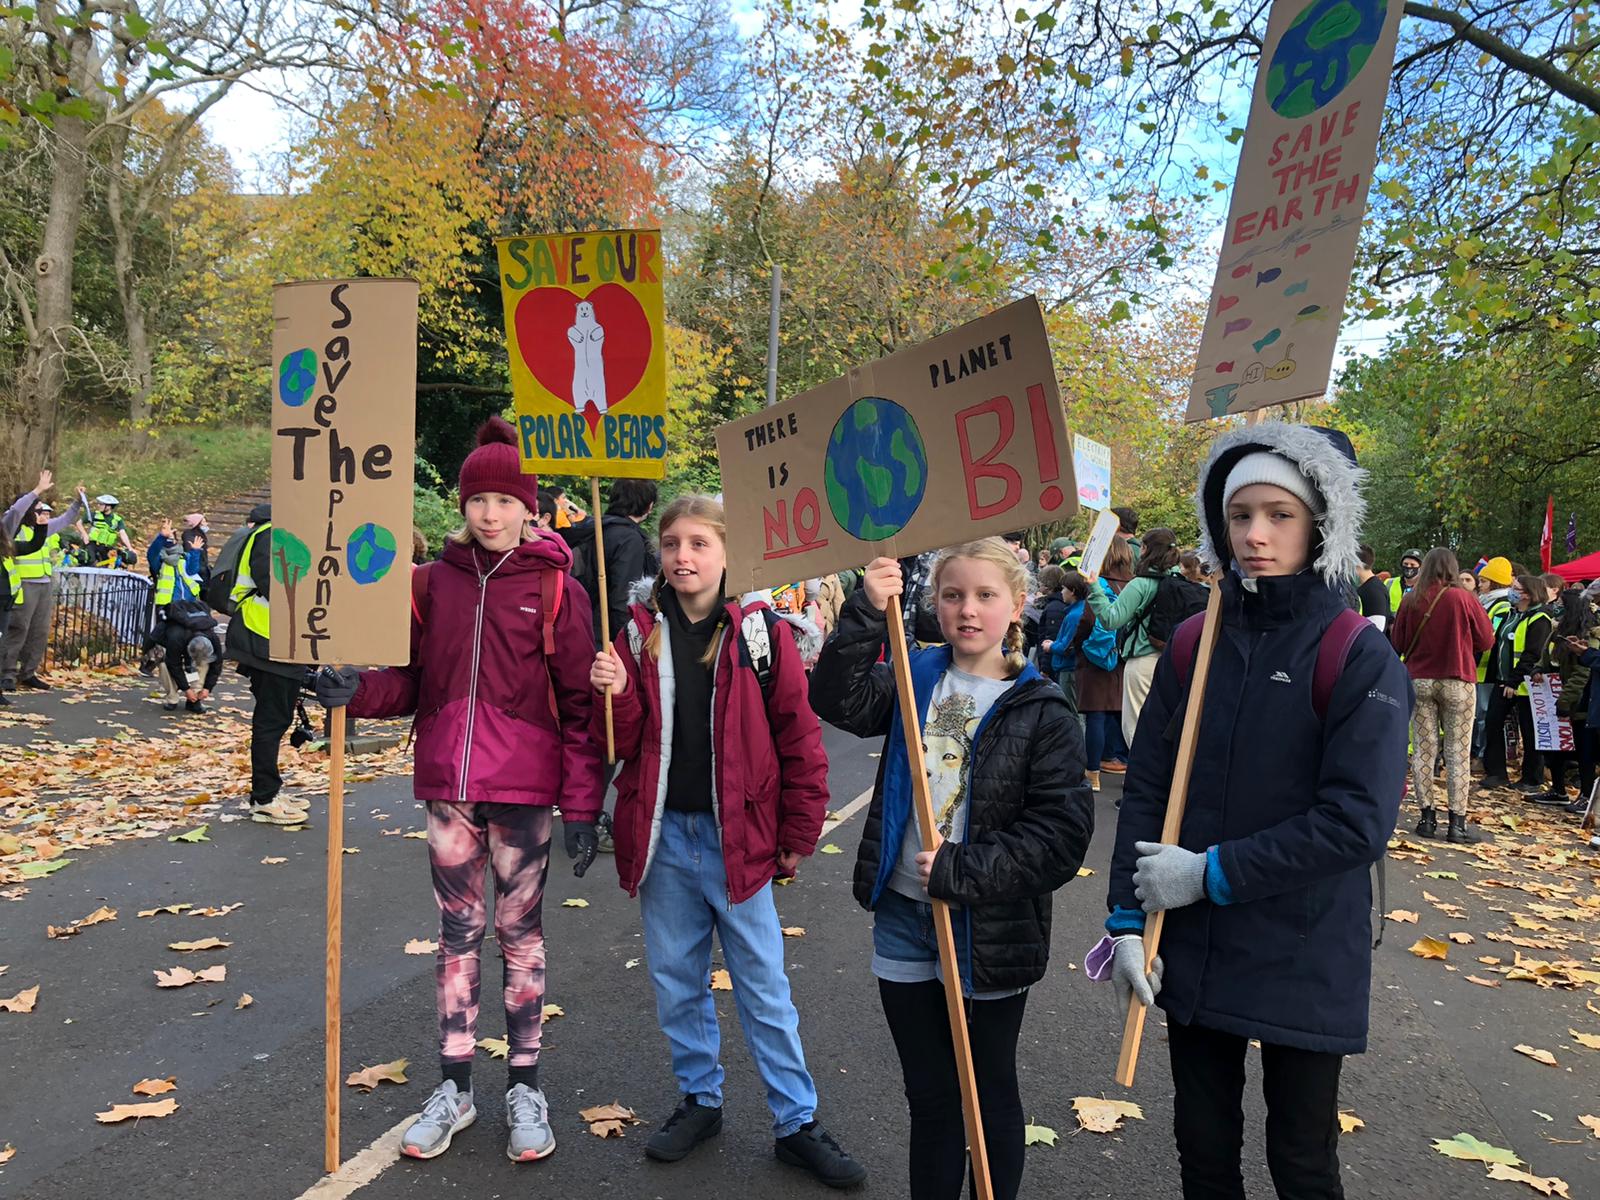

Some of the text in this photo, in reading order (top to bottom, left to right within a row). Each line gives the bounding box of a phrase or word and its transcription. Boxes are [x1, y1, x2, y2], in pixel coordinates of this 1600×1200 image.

[1267, 101, 1362, 167] SAVE
[1272, 145, 1343, 196] THE
[1232, 174, 1361, 245] EARTH
[504, 234, 658, 290] SAVE OUR
[929, 334, 1013, 388] PLANET
[1245, 367, 1261, 381] HI
[277, 427, 393, 485] The
[519, 413, 668, 460] POLAR BEARS
[744, 412, 799, 452] THERE
[955, 382, 1064, 522] B!
[767, 462, 790, 489] IS
[763, 487, 821, 552] NO
[1532, 692, 1548, 717] LOVE
[1537, 721, 1553, 749] JUSTICE
